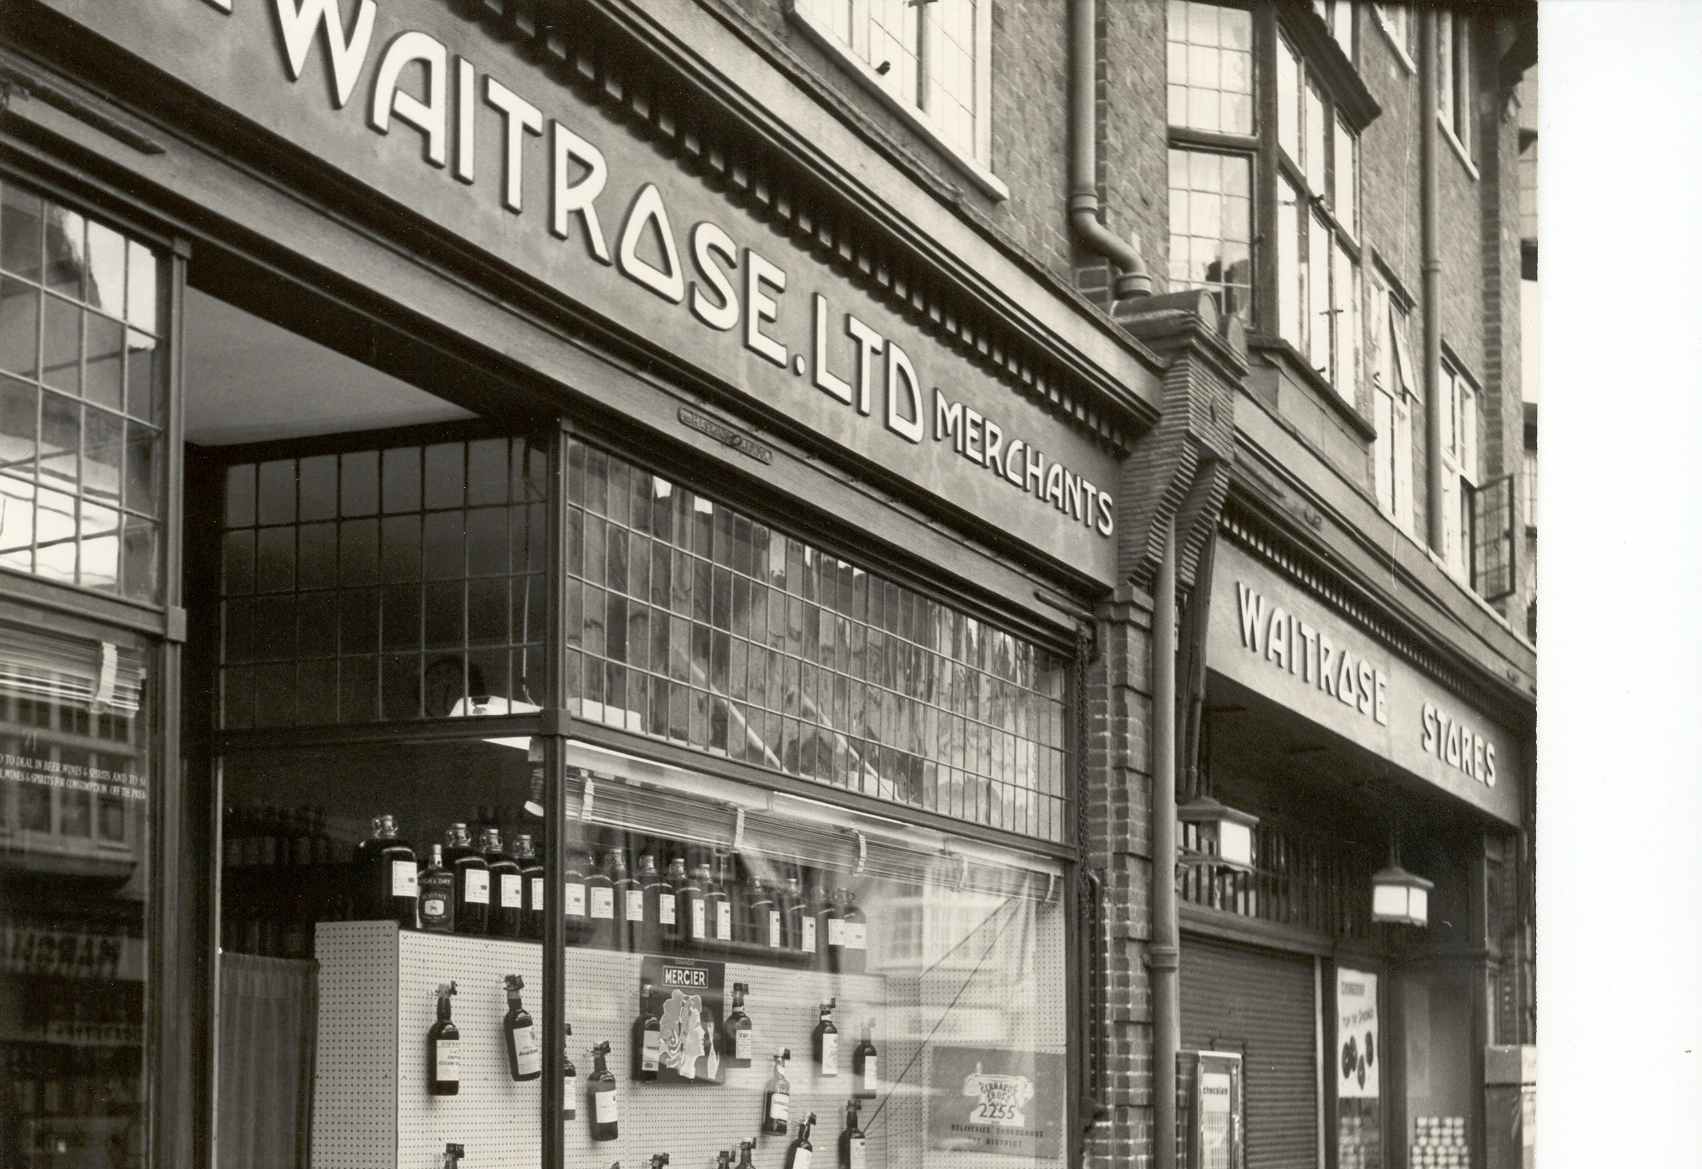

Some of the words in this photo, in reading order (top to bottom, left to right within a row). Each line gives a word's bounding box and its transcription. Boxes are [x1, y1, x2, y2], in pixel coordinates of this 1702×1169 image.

[815, 292, 925, 443] LTD
[934, 388, 1115, 537] MERCHANTS
[1237, 580, 1389, 726] WAITROSE
[1422, 701, 1497, 788] STORES
[664, 968, 706, 986] MERCIER
[978, 1102, 1017, 1120] 2255
